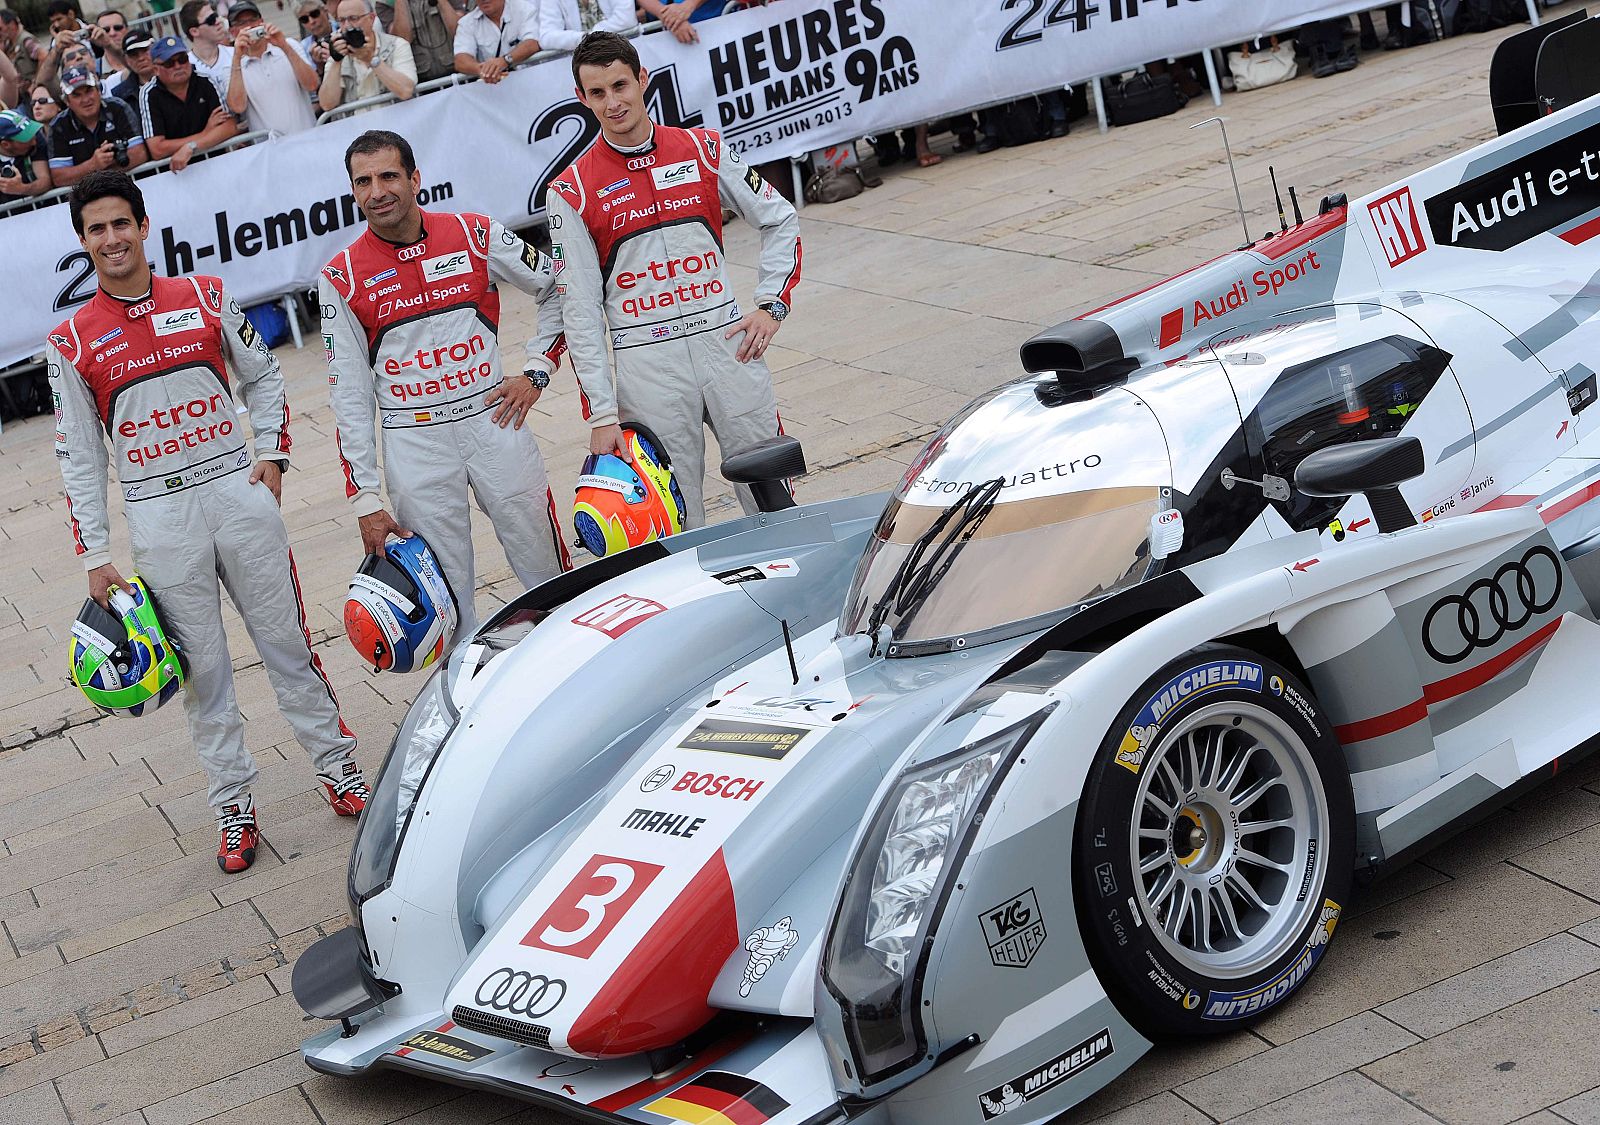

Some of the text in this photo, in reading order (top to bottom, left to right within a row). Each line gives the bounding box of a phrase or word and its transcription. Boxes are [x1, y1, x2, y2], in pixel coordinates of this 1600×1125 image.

[709, 0, 885, 97] HEURES
[718, 62, 835, 127] DU MANS
[879, 63, 920, 96] ANS
[728, 102, 853, 154] 22-23 JUIN 2013
[612, 192, 636, 207] BOSCH
[629, 195, 702, 221] Audi Sport
[1450, 150, 1600, 244] Audi e-t
[1370, 191, 1419, 264] HY
[377, 283, 402, 297] BOSCH
[615, 250, 719, 290] e-tron
[1193, 249, 1322, 327] Audi Sport
[394, 283, 471, 311] Audi Sport
[622, 278, 724, 318] quattro
[685, 318, 708, 330] Jarvis
[105, 341, 129, 358] BOSCH
[127, 341, 204, 371] Audi Sport
[384, 334, 485, 376] e-tron
[391, 361, 492, 402] quattro
[118, 393, 226, 438] e-tron
[126, 420, 233, 467] quattro
[912, 476, 973, 494] e-tron
[1470, 475, 1495, 496] Jarvis
[1431, 499, 1456, 518] Gené
[1150, 665, 1260, 722] MICHELIN
[1286, 685, 1316, 719] MICHELIN
[1283, 693, 1322, 739] Total Performance
[671, 771, 765, 801] BOSCH
[620, 808, 707, 839] MAHLE
[1229, 810, 1240, 856] RACING
[539, 862, 636, 948] 3
[990, 900, 1031, 938] TAG
[993, 925, 1043, 963] HEUER
[1147, 968, 1183, 1002] MICHELIN
[1207, 951, 1314, 1016] MICHELIN
[1024, 1034, 1108, 1092] MICHELIN
